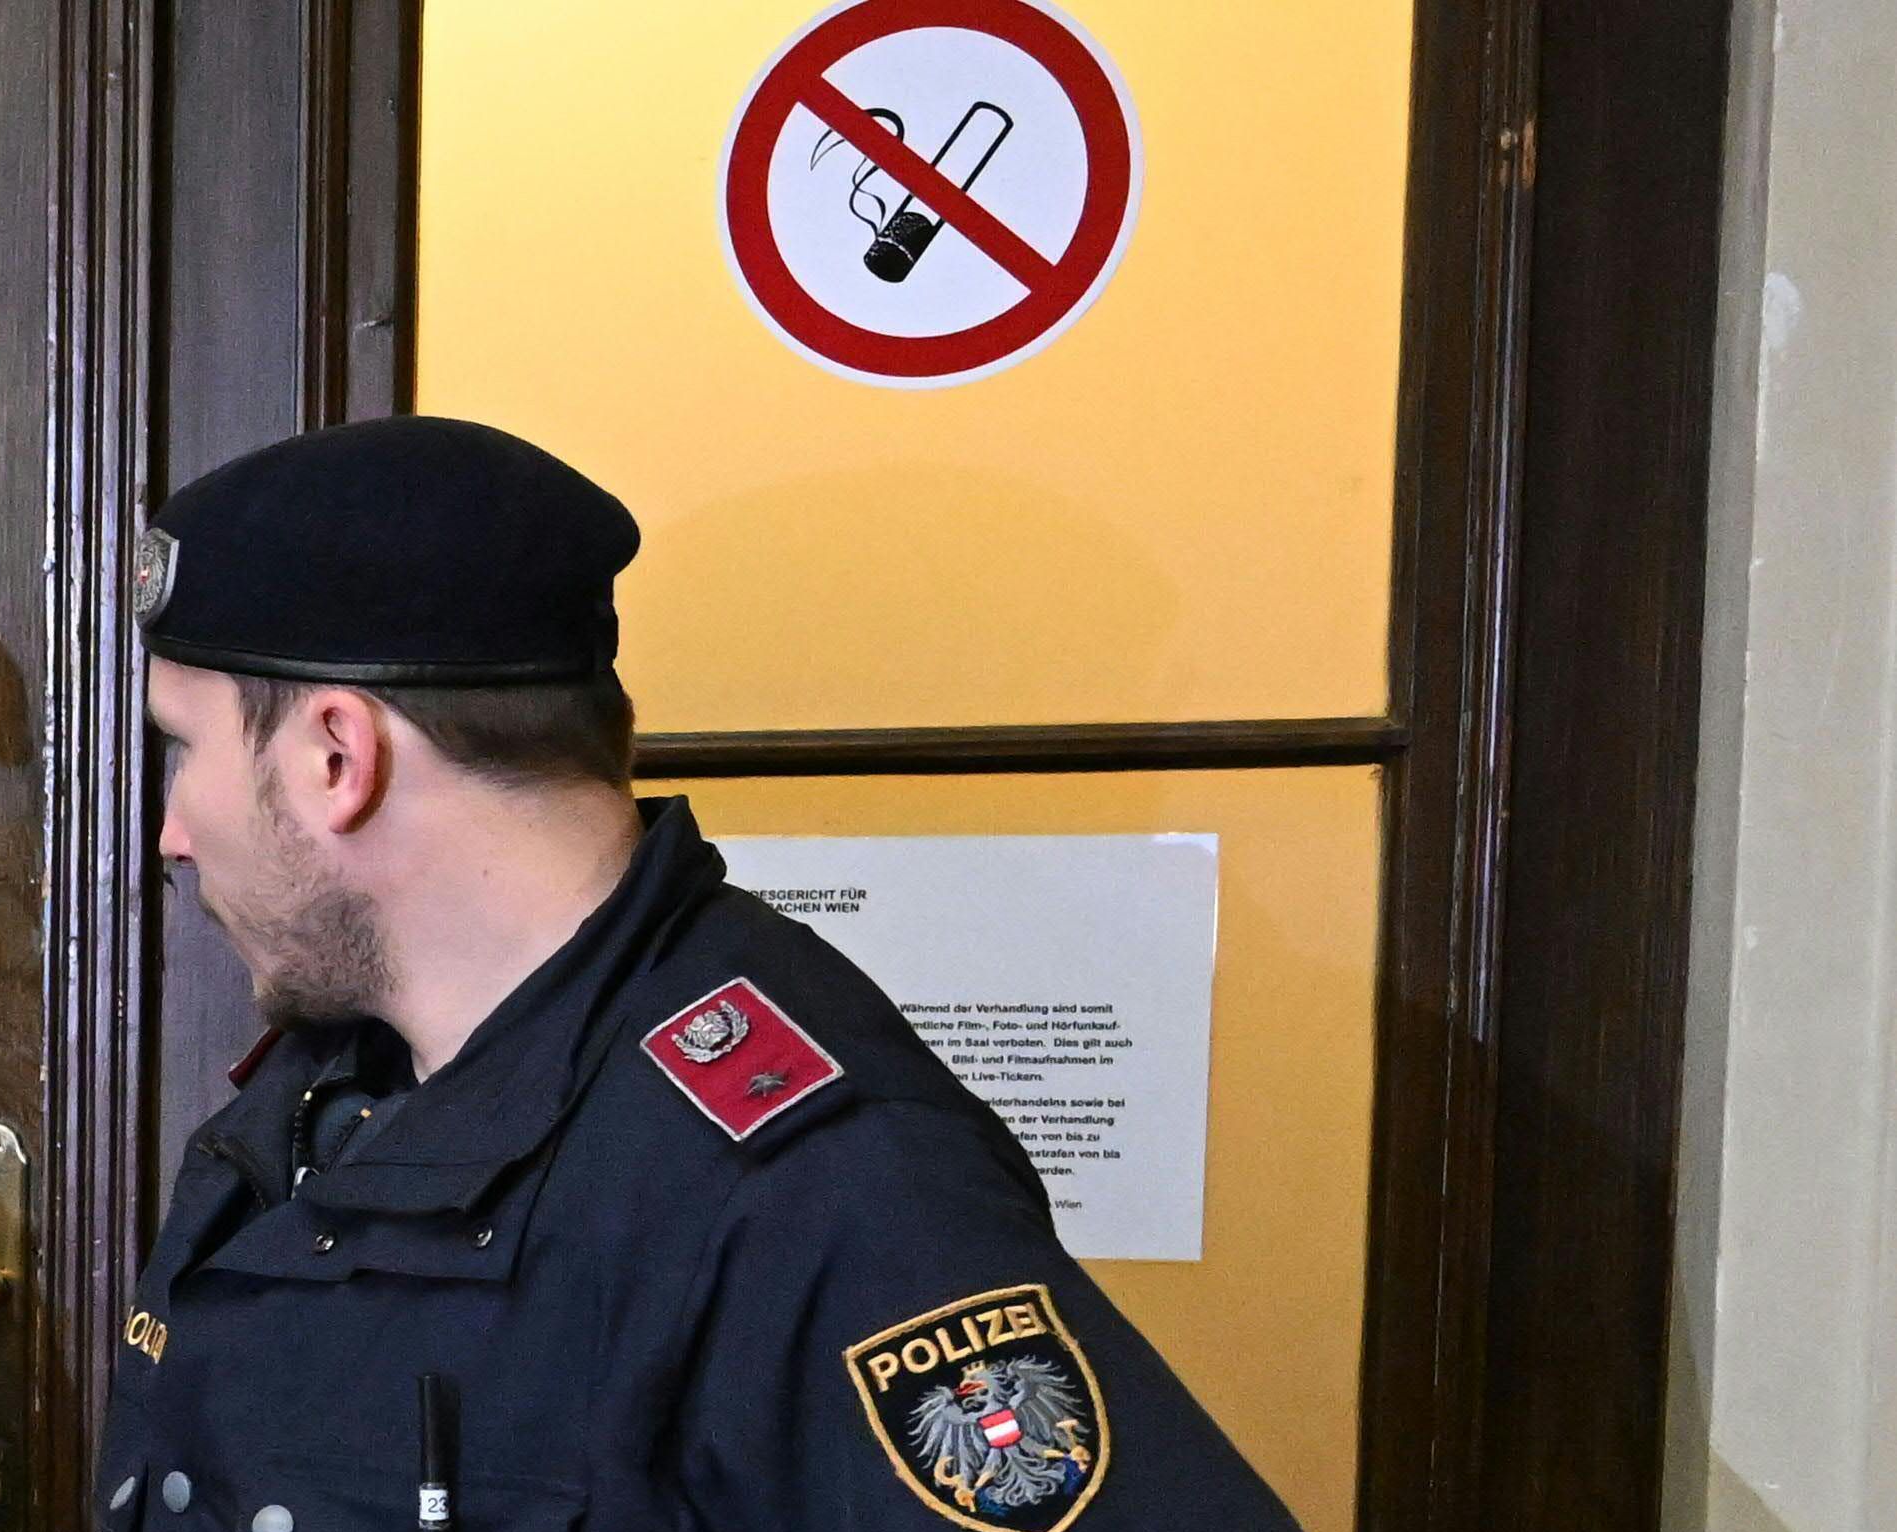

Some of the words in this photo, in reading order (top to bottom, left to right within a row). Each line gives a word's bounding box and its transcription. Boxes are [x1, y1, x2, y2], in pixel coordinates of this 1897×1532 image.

[840, 886, 867, 900] FÜR
[825, 902, 860, 913] WIEN
[900, 1003, 950, 1014] Während
[953, 1003, 972, 1014] der
[976, 1003, 1049, 1016] Verhandlung
[1052, 1003, 1077, 1014] sind
[1081, 1003, 1113, 1014] somit
[911, 1020, 954, 1031] mtliche
[993, 1021, 1023, 1031] Foto-
[1026, 1021, 1048, 1031] und
[1052, 1020, 1121, 1032] Hörfunkauf-
[947, 1037, 961, 1048] im
[965, 1037, 989, 1048] Saal
[993, 1037, 1047, 1048] verboten.
[1054, 1037, 1079, 1048] Dies
[1083, 1037, 1101, 1050] gilt
[1105, 1037, 1133, 1049] auch
[982, 1055, 1004, 1065] und
[1007, 1054, 1096, 1066] Filmaufnahmen
[1100, 1055, 1114, 1065] im
[972, 1071, 1044, 1082] Live-Tickern.
[1070, 1098, 1103, 1107] sowie
[1107, 1097, 1125, 1107] bei
[1019, 1114, 1038, 1124] der
[1041, 1114, 1115, 1127] Verhandlung
[1041, 1133, 1063, 1142] von
[1066, 1131, 1084, 1141] bis
[1087, 1132, 1101, 1141] zu
[1078, 1150, 1100, 1159] von
[1103, 1148, 1121, 1159] bis
[1054, 1199, 1083, 1209] Wien
